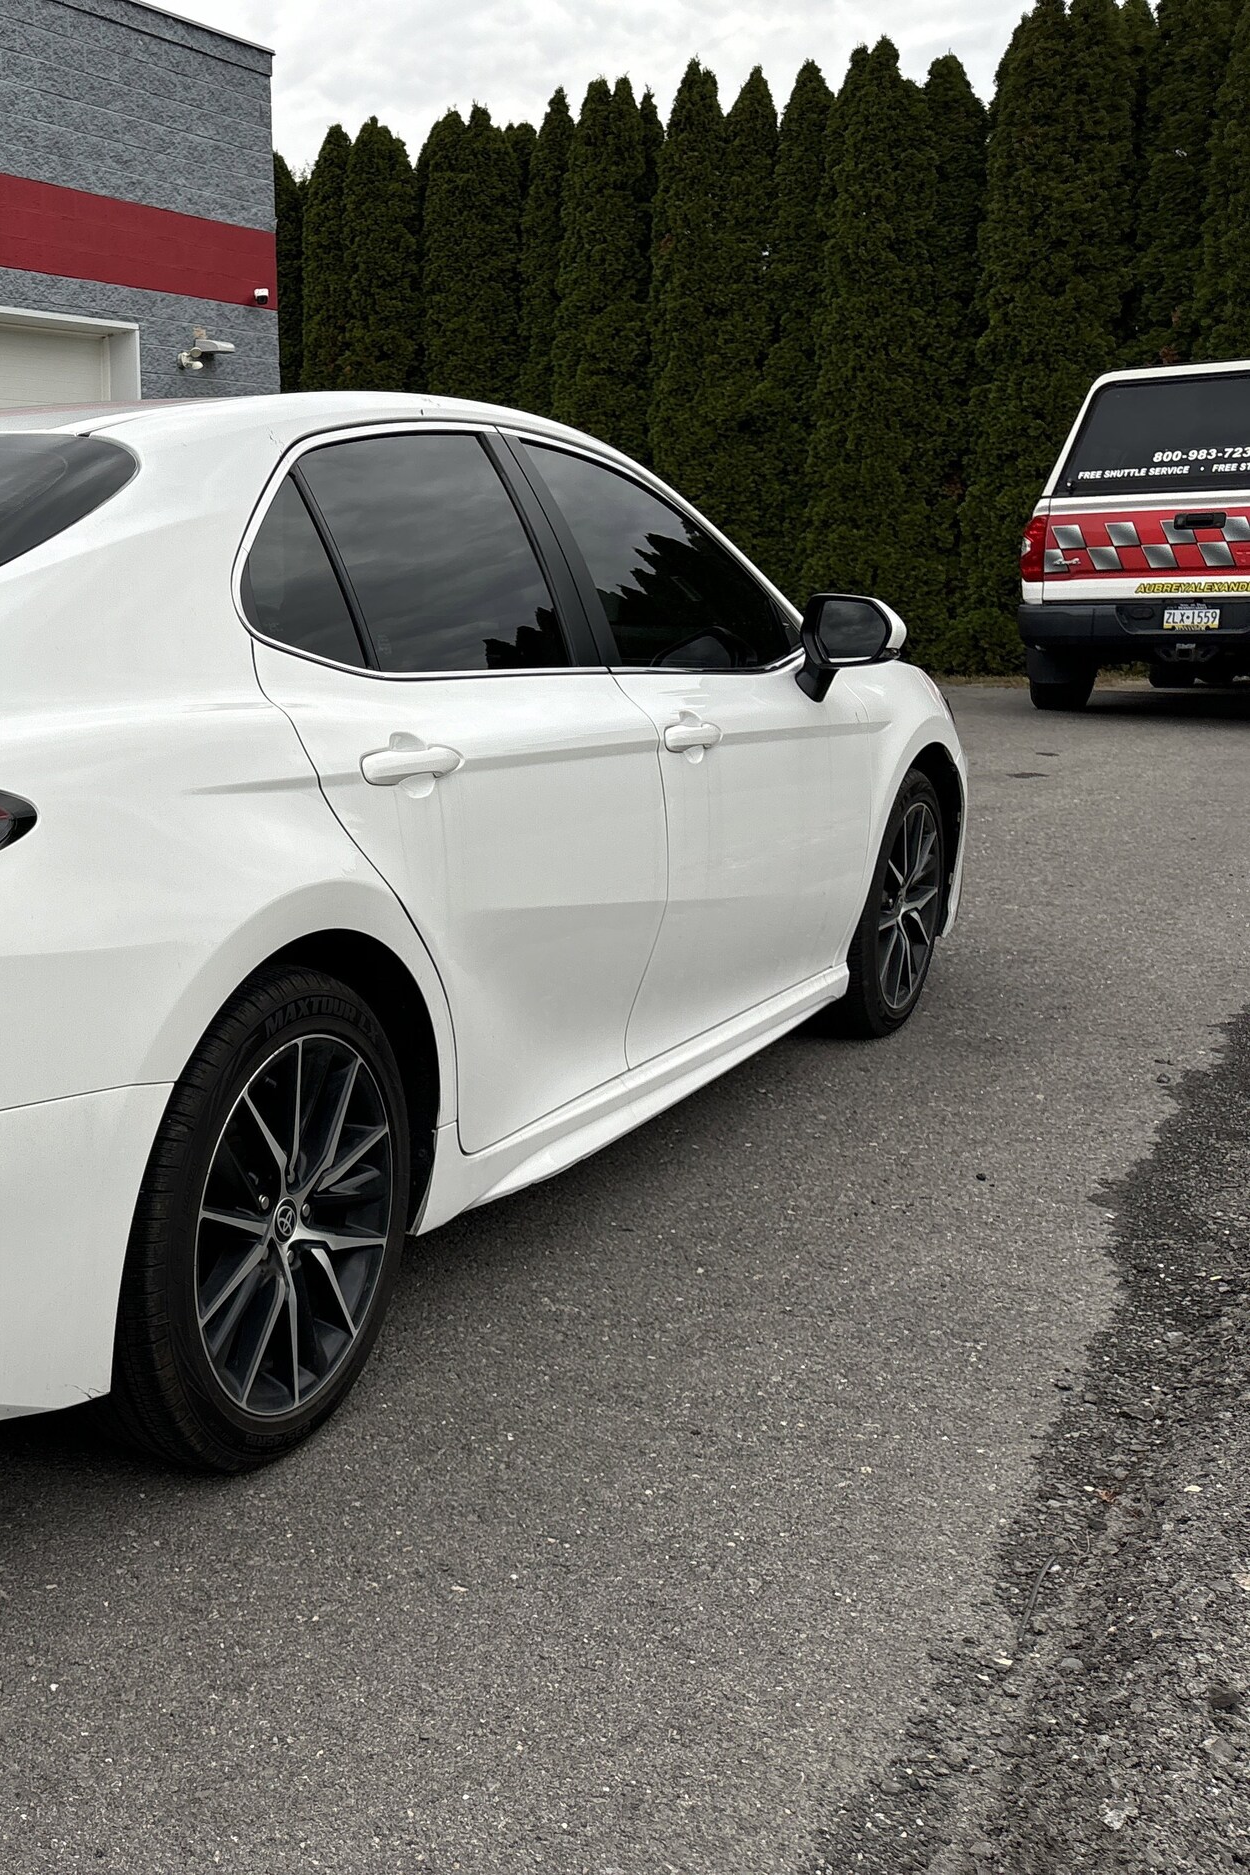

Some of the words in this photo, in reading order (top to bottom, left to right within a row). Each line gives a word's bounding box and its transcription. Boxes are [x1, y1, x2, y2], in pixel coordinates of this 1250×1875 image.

[1078, 470, 1102, 480] FREE
[1103, 467, 1147, 478] SHUTTLE
[1148, 465, 1190, 476] SERVICE
[1212, 463, 1238, 473] FREE
[264, 996, 358, 1038] MAXTOUR
